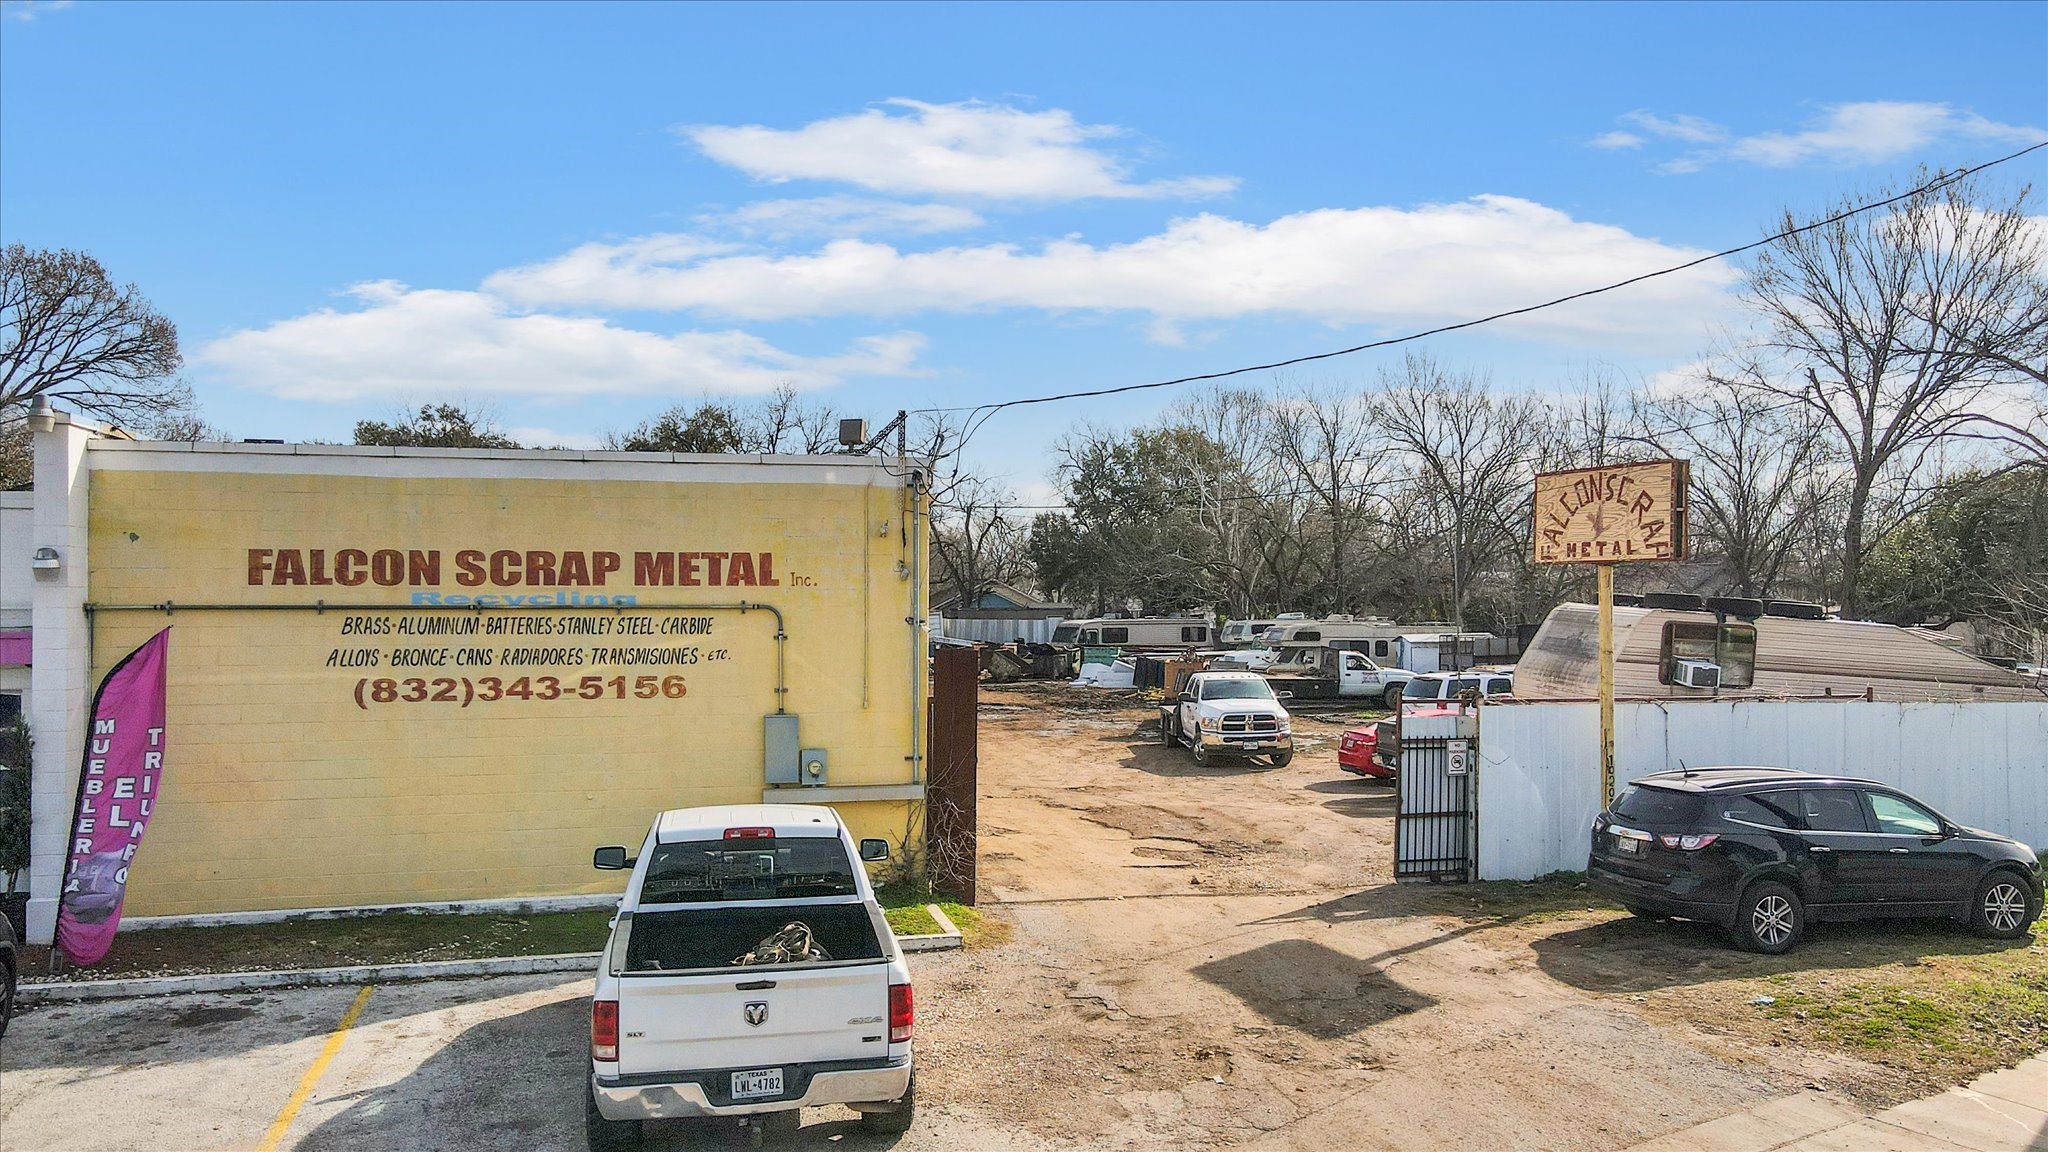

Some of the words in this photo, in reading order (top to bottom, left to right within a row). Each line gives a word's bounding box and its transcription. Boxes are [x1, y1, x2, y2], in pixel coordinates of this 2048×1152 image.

[1566, 539, 1637, 558] METAL
[248, 549, 440, 586] FALCON
[455, 550, 621, 586] SCRAP
[634, 551, 780, 587] METAL
[790, 571, 818, 587] Inc.
[410, 591, 637, 606] Recycling
[341, 616, 391, 635] BRASS
[397, 616, 479, 635] ALUMINUM
[486, 616, 553, 635] BATTERIES
[556, 616, 614, 635] STANLEY
[616, 616, 654, 635] STEEL
[660, 616, 714, 635] CARBIDE
[326, 648, 379, 667] ALLOYS
[391, 648, 448, 667] BRONCE
[456, 648, 493, 667] CANS
[500, 648, 583, 666] RADIADORES
[591, 647, 698, 666] TRANSMISIONES
[354, 675, 687, 710] (832)343-5156
[64, 718, 116, 893] MUEBLERIA
[109, 777, 135, 828] EL
[747, 1070, 767, 1078] TEXAS
